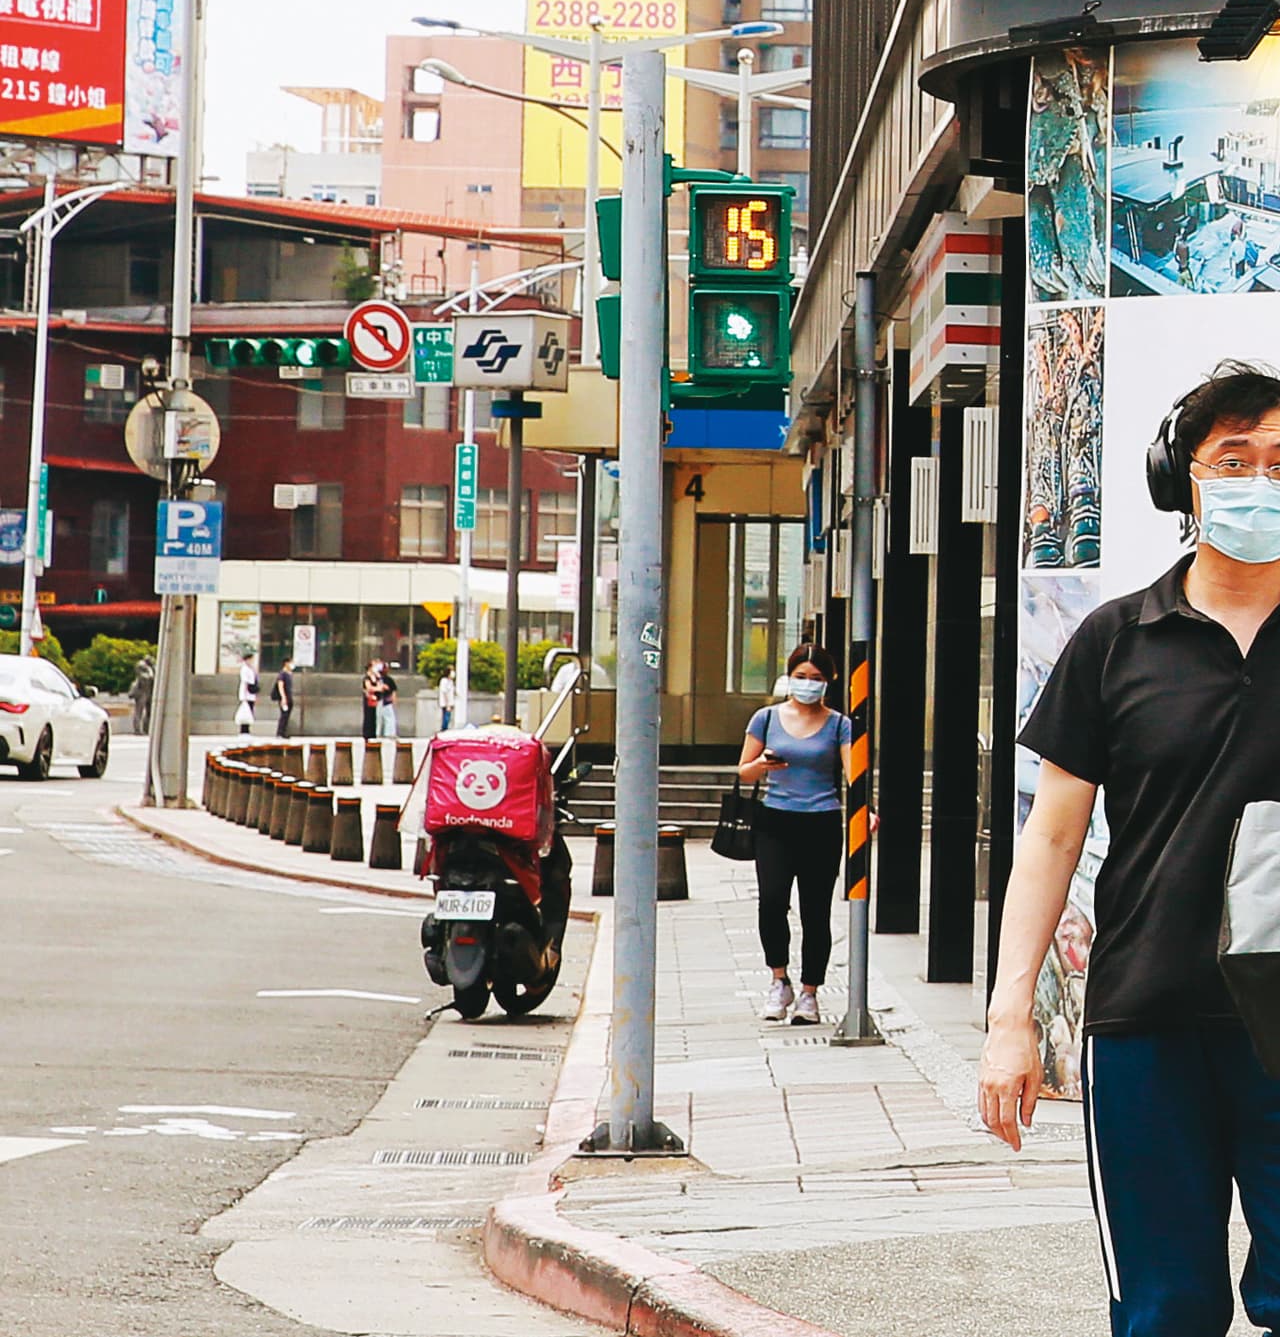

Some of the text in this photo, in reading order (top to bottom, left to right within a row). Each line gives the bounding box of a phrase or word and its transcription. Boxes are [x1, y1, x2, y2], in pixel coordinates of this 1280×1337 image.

[536, 0, 677, 29] 2388-2288
[1, 77, 41, 102] 215
[726, 199, 776, 270] 15
[684, 473, 705, 503] 4
[166, 501, 207, 539] P
[186, 541, 213, 556] 40M
[445, 812, 514, 830] foodpanda
